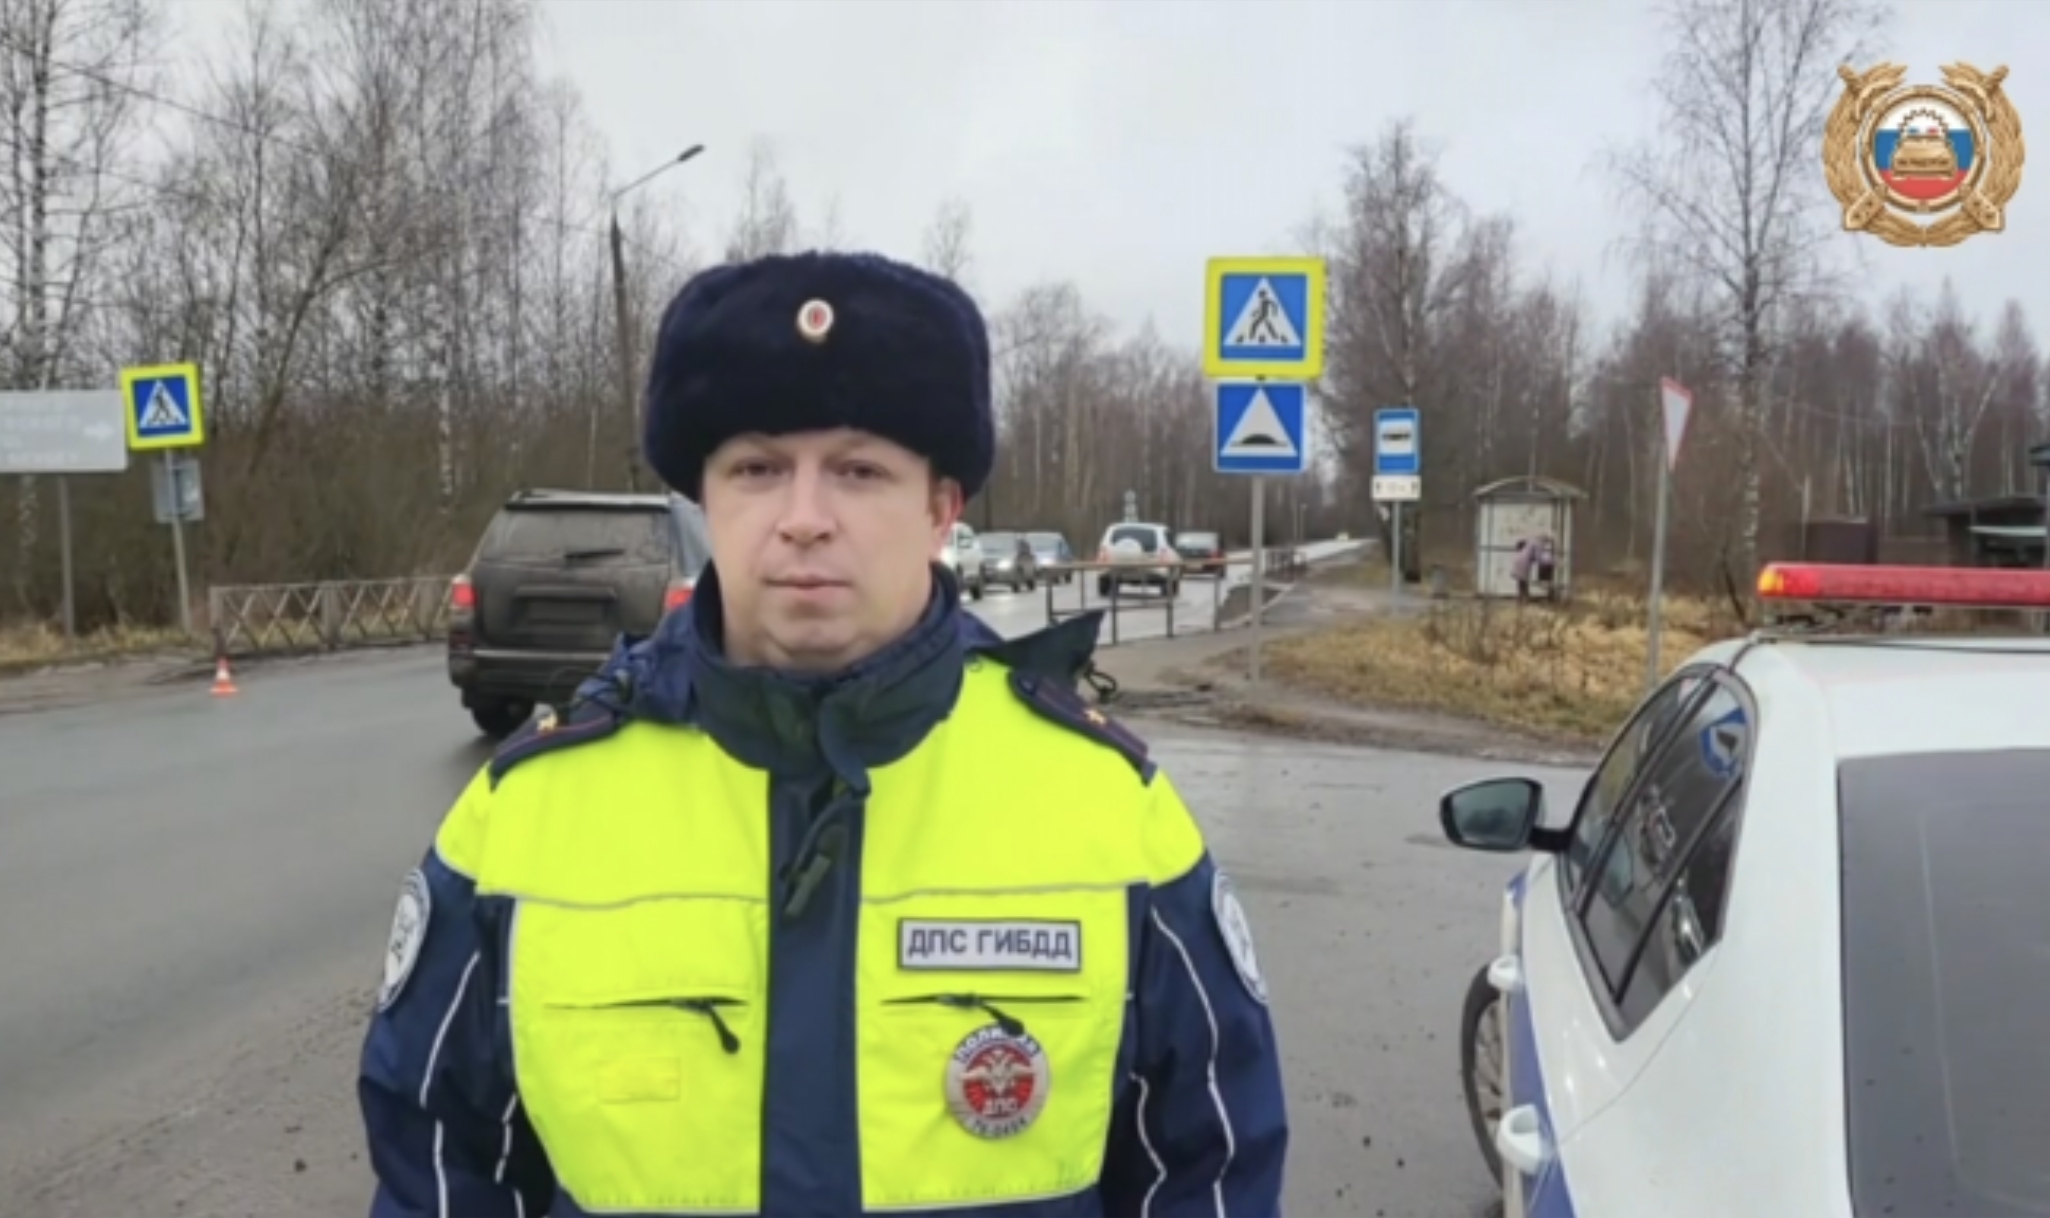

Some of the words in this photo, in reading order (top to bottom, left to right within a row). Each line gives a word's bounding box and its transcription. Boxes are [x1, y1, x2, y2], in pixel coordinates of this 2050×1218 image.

[908, 928, 967, 958] ДПС
[978, 929, 1072, 960] ГИБДД
[953, 1027, 1041, 1063] ПОЛИИЯ
